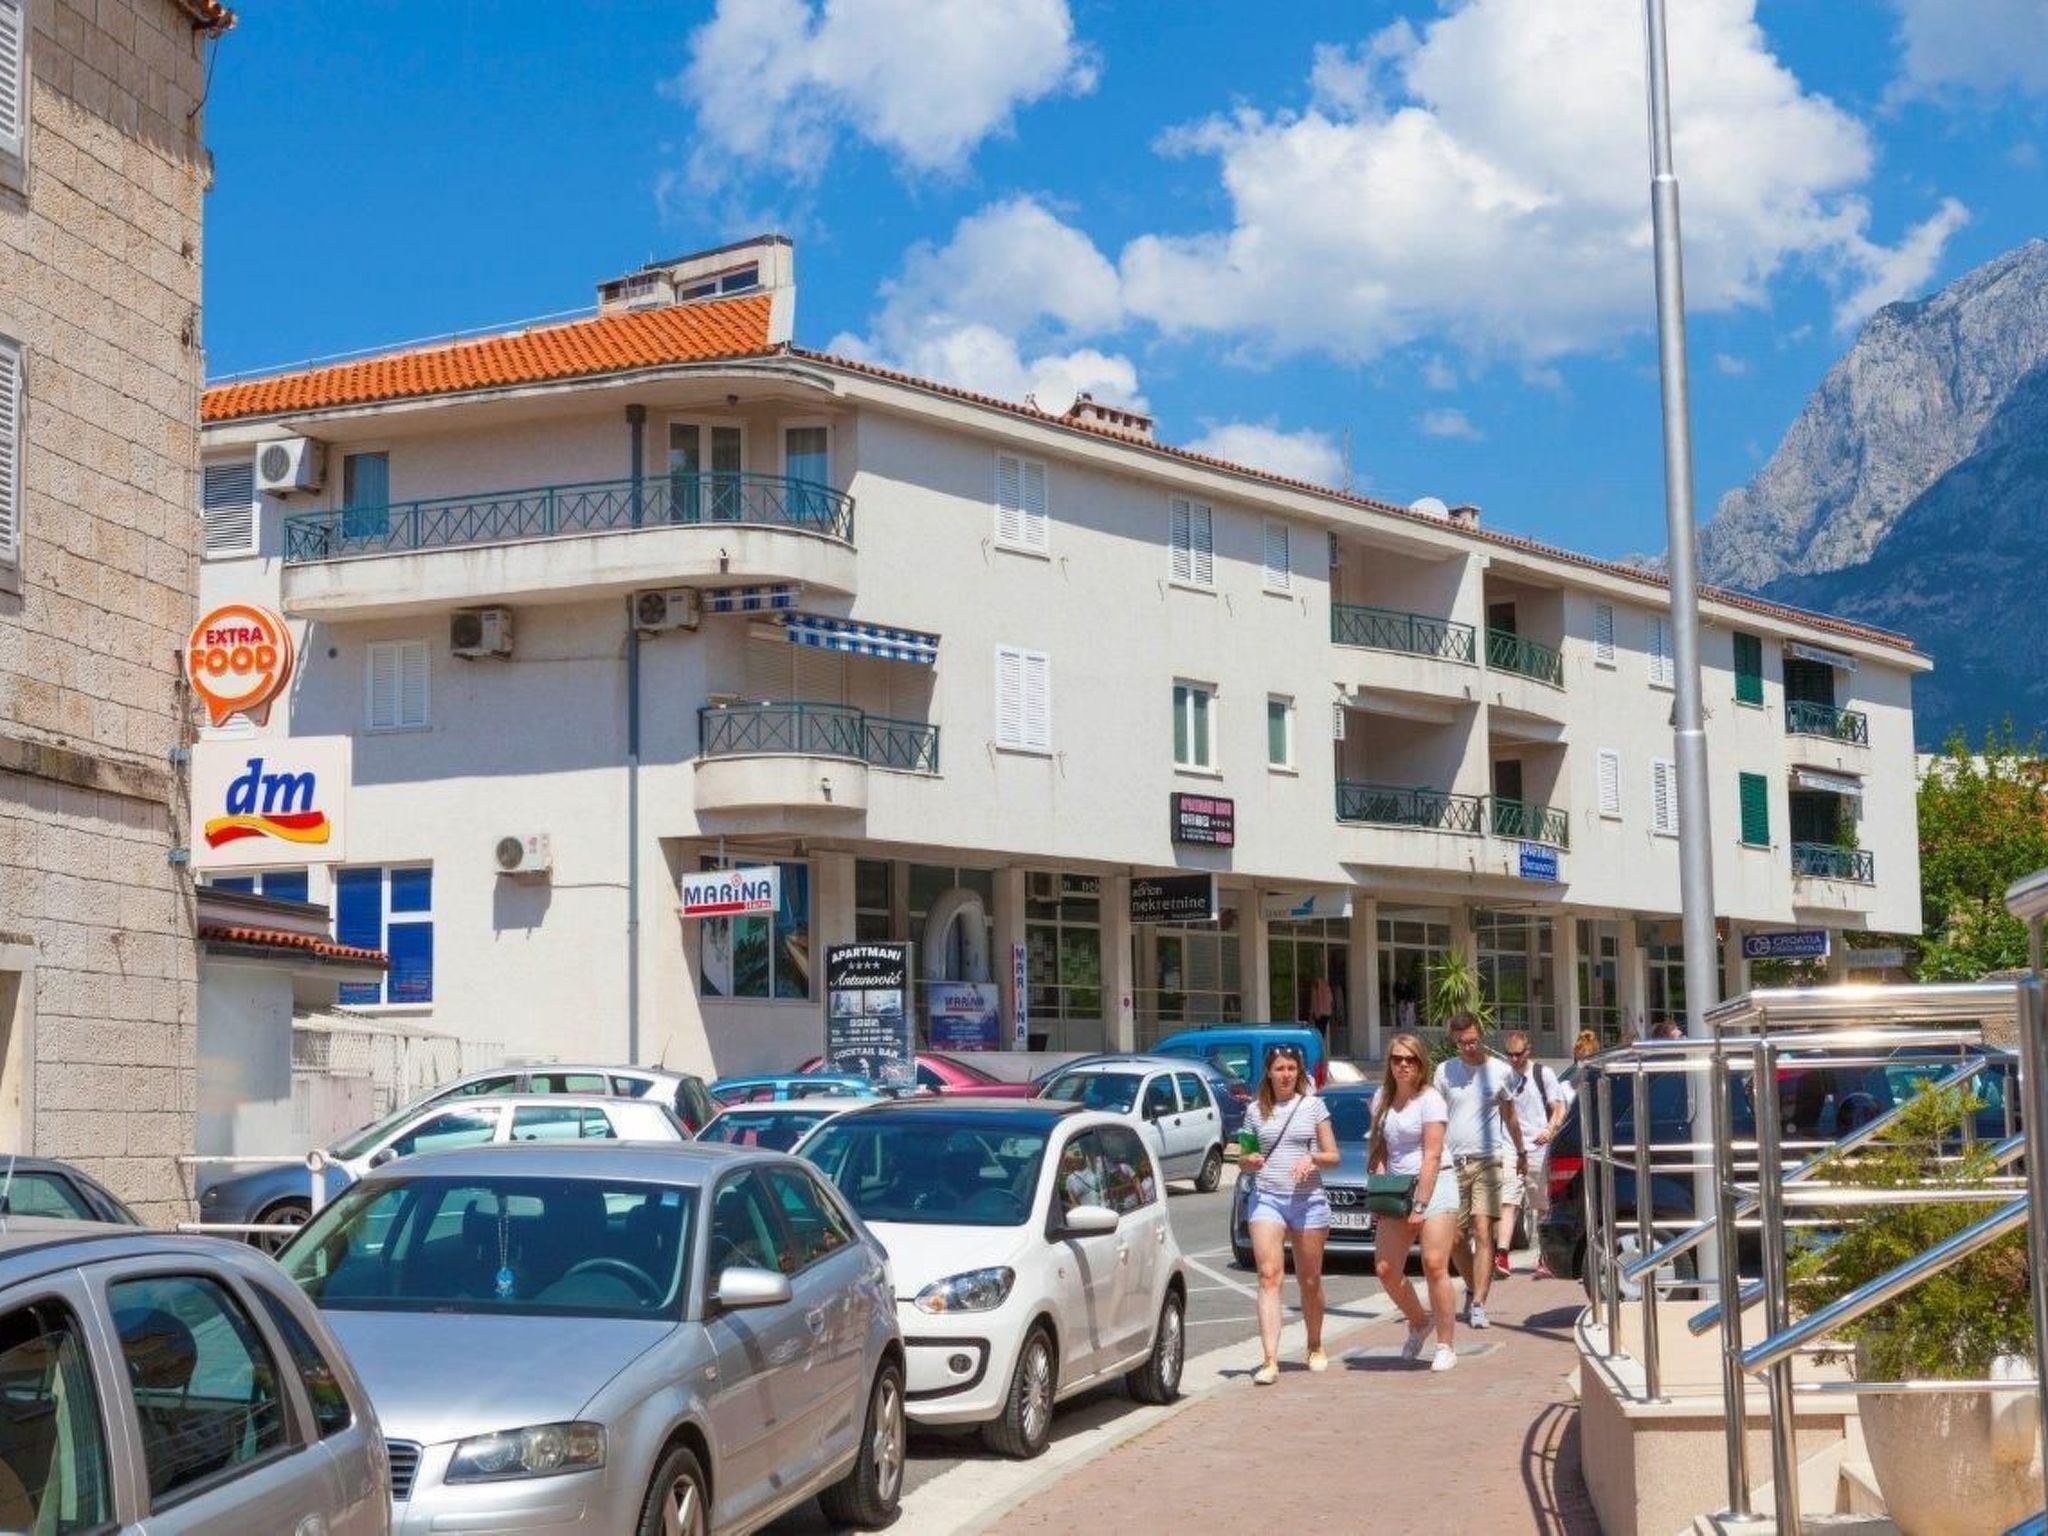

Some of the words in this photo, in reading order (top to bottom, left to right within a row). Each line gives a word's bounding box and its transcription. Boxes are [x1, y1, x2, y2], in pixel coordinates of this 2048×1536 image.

[205, 626, 264, 646] EXTRA
[190, 645, 277, 676] FOOD
[225, 757, 316, 817] dm
[1132, 896, 1207, 912] nekretnine
[1772, 935, 1822, 946] CROATIA
[831, 946, 902, 964] APARTMANI
[1015, 948, 1026, 1038] MARINA
[833, 1047, 875, 1060] COCKTAIL
[878, 1047, 899, 1059] BAR
